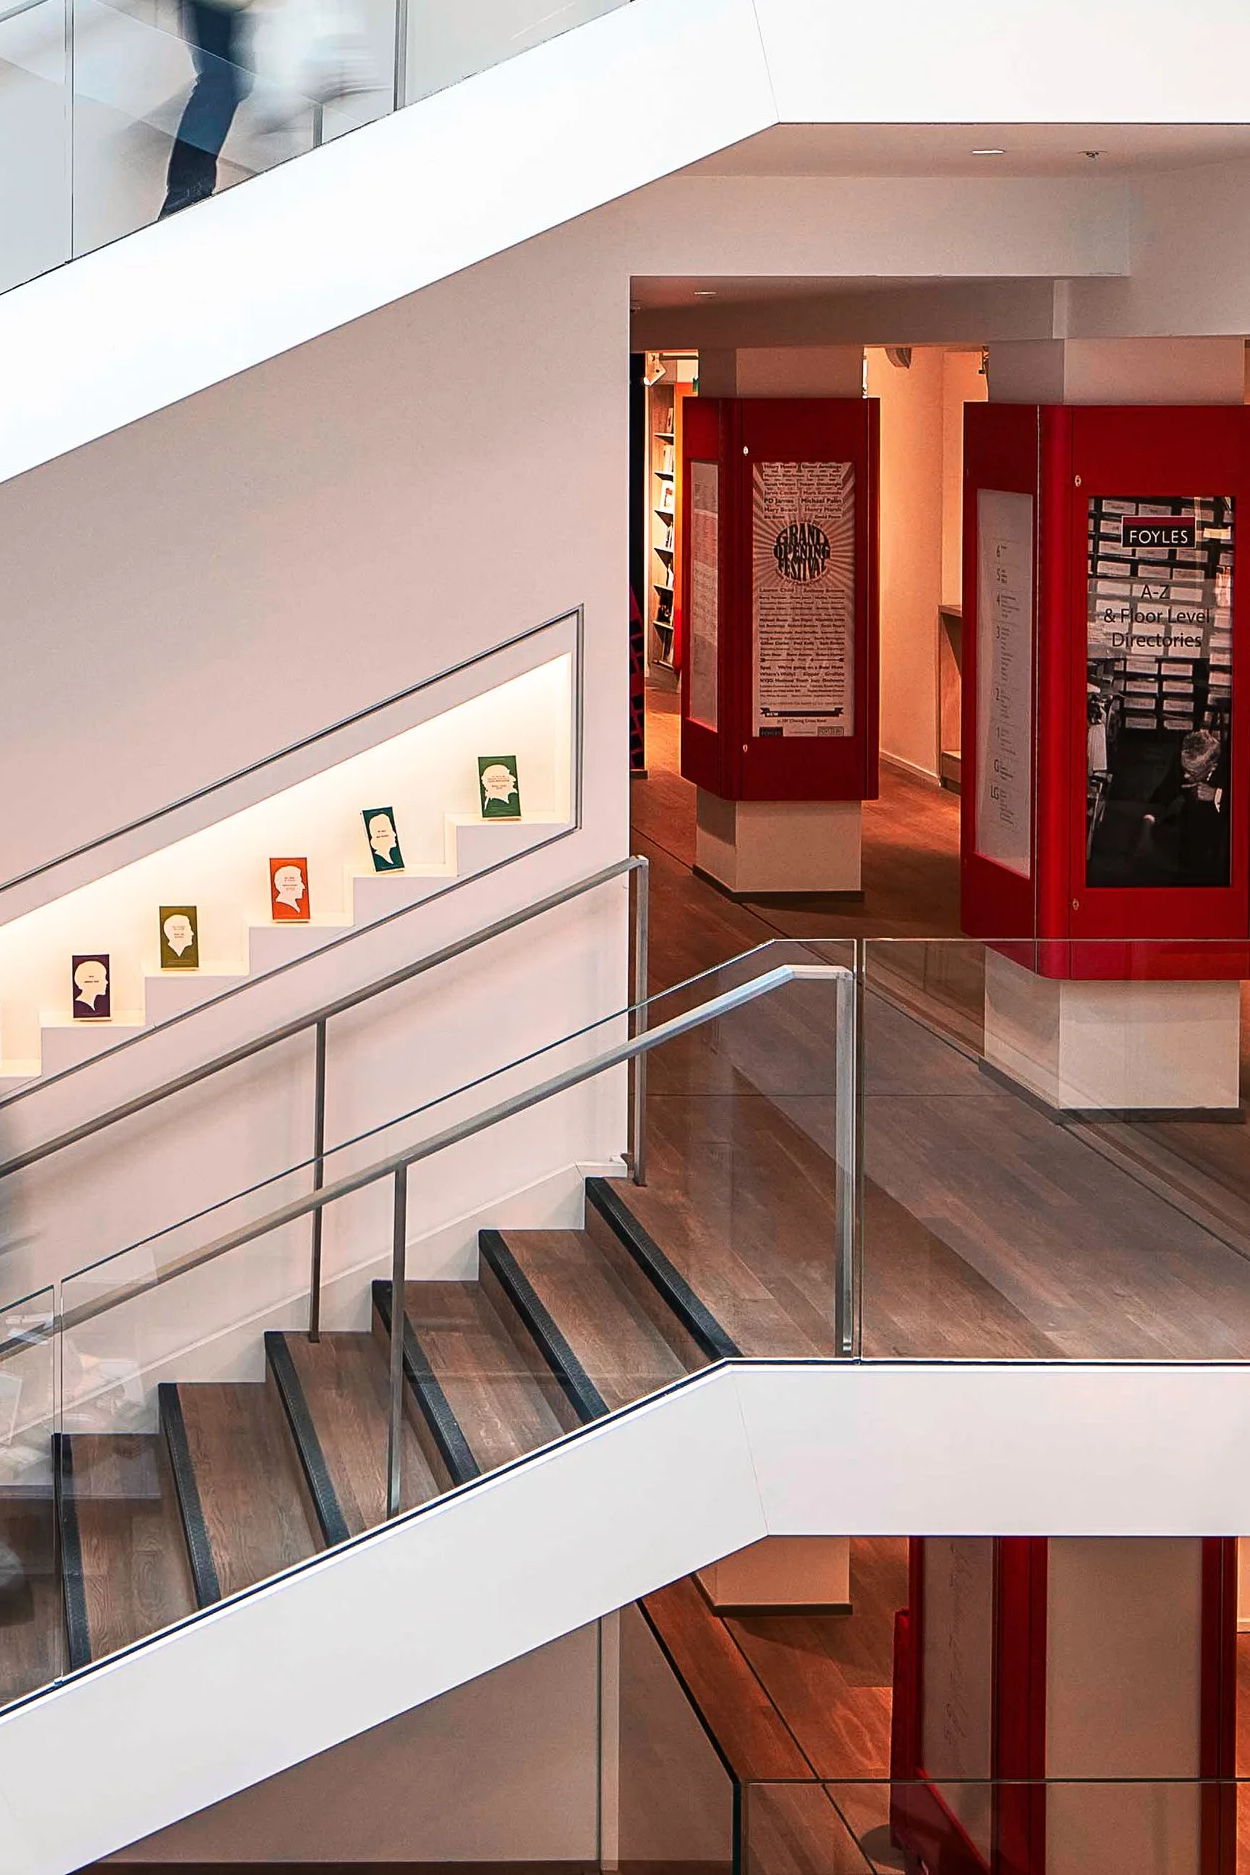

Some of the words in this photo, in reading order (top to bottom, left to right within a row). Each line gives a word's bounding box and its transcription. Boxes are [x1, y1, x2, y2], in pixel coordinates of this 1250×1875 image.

[775, 523, 829, 546] GRAND
[1129, 530, 1189, 544] FOYLES
[773, 544, 831, 559] OPENING
[778, 557, 828, 582] FESTIVAL
[1140, 585, 1171, 600] A-Z
[1103, 608, 1117, 624] &
[1119, 607, 1163, 624] Floor
[1167, 607, 1210, 624] Level
[1111, 632, 1202, 649] Directories
